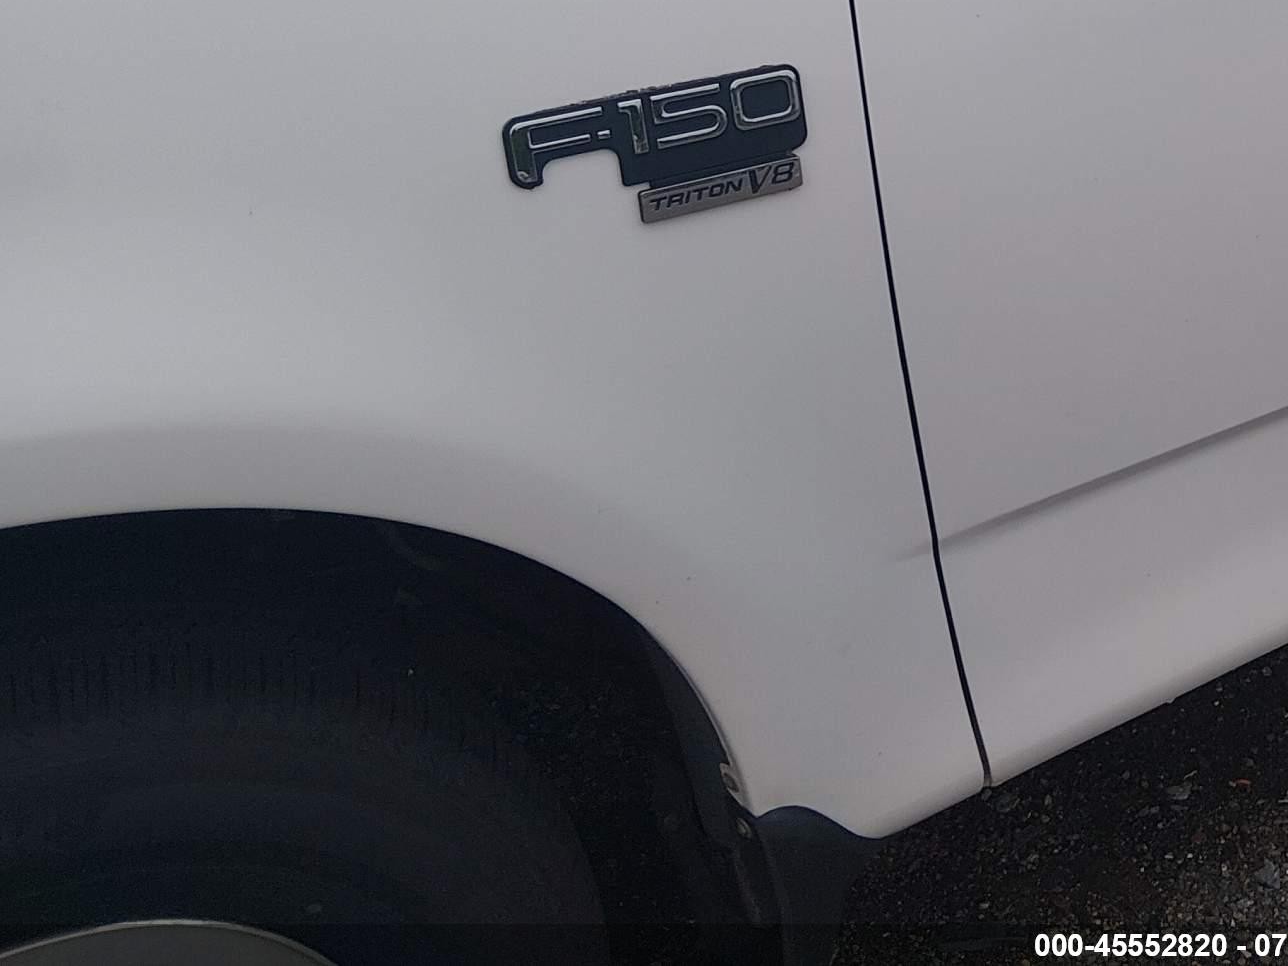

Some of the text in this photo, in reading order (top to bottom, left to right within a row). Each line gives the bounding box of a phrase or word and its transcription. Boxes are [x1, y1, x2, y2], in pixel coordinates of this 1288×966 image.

[508, 68, 801, 184] F-150
[650, 161, 795, 212] TRITON V8
